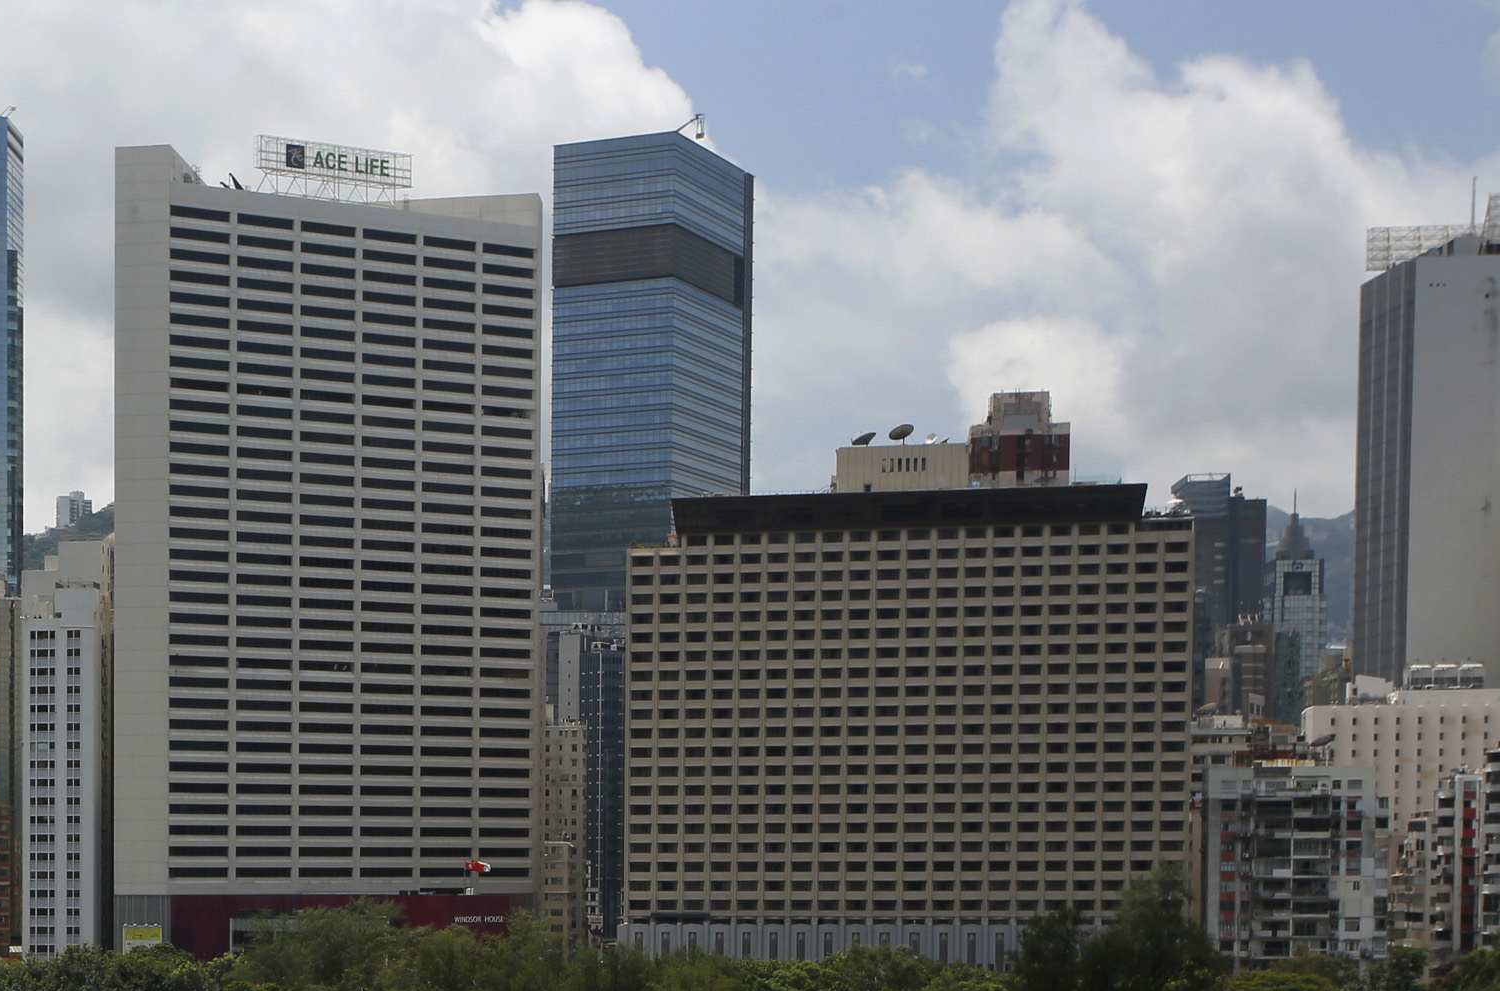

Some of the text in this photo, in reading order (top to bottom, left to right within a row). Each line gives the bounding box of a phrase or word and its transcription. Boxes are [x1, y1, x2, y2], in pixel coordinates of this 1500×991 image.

[313, 151, 390, 176] ACE LIFE
[454, 915, 505, 923] WINDSOR HOUSE
